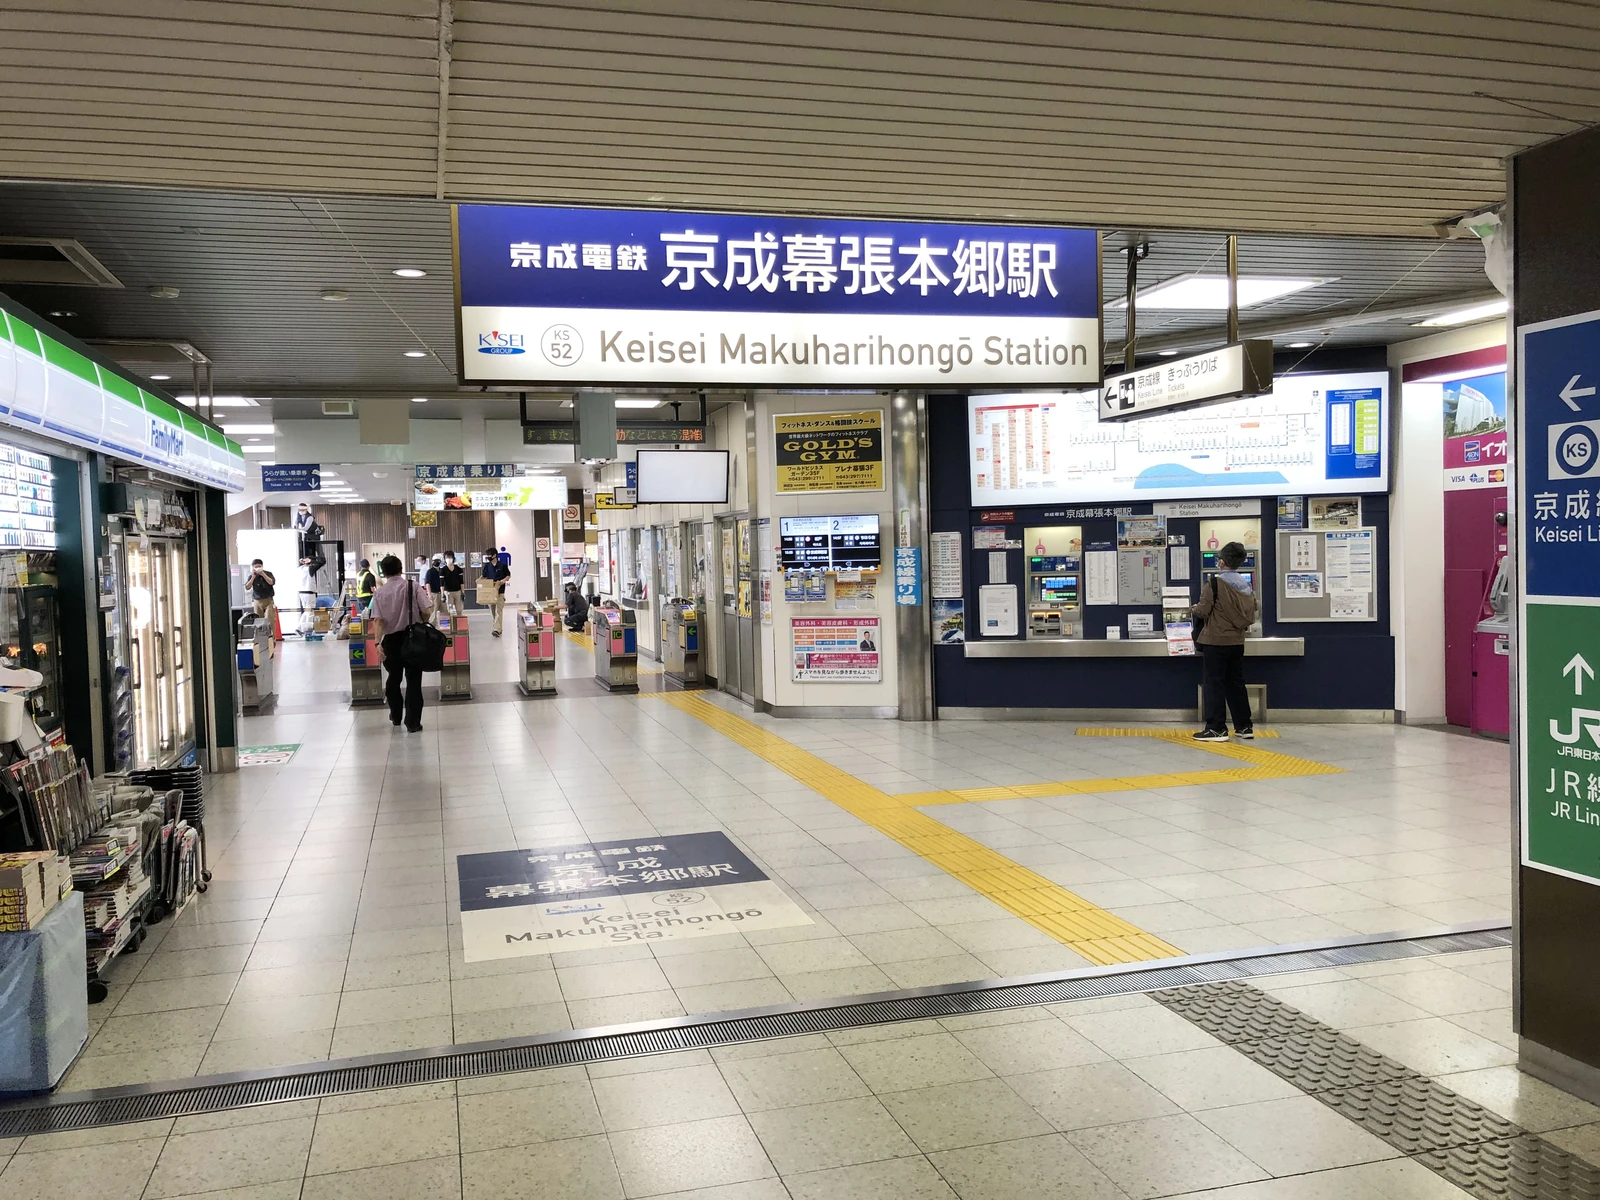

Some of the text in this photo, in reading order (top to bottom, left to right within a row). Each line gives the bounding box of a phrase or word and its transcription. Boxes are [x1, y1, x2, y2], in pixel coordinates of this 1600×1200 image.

[510, 230, 1059, 299] 京成電鉄 京成幕張本郷駅
[554, 329, 570, 341] KS
[550, 343, 573, 359] 52
[600, 330, 1088, 374] Keisei Makuharihongō Station
[1137, 355, 1218, 389] 京成線 きっぷうりば
[151, 419, 184, 457] FamilyMart
[783, 437, 873, 452] GOLD'S
[799, 449, 857, 462] GYM
[1565, 442, 1588, 458] KS
[418, 465, 513, 478] 京成線乗り場
[1451, 475, 1466, 483] VISA
[1066, 507, 1132, 519] 京成幕張本郷駅
[1533, 489, 1600, 521] 京成
[783, 521, 789, 532] 1
[832, 519, 840, 531] 2
[1535, 526, 1582, 543] Keisei
[896, 547, 917, 605] 京成線乗り場
[529, 634, 538, 642] IC
[613, 631, 622, 639] IC
[1550, 800, 1571, 820] JR
[485, 863, 740, 899] 幕張本郷駅
[666, 896, 695, 905] 52
[582, 907, 682, 925] Keisei
[505, 908, 763, 944] Makuharihongō
[610, 931, 674, 943] Sta.
